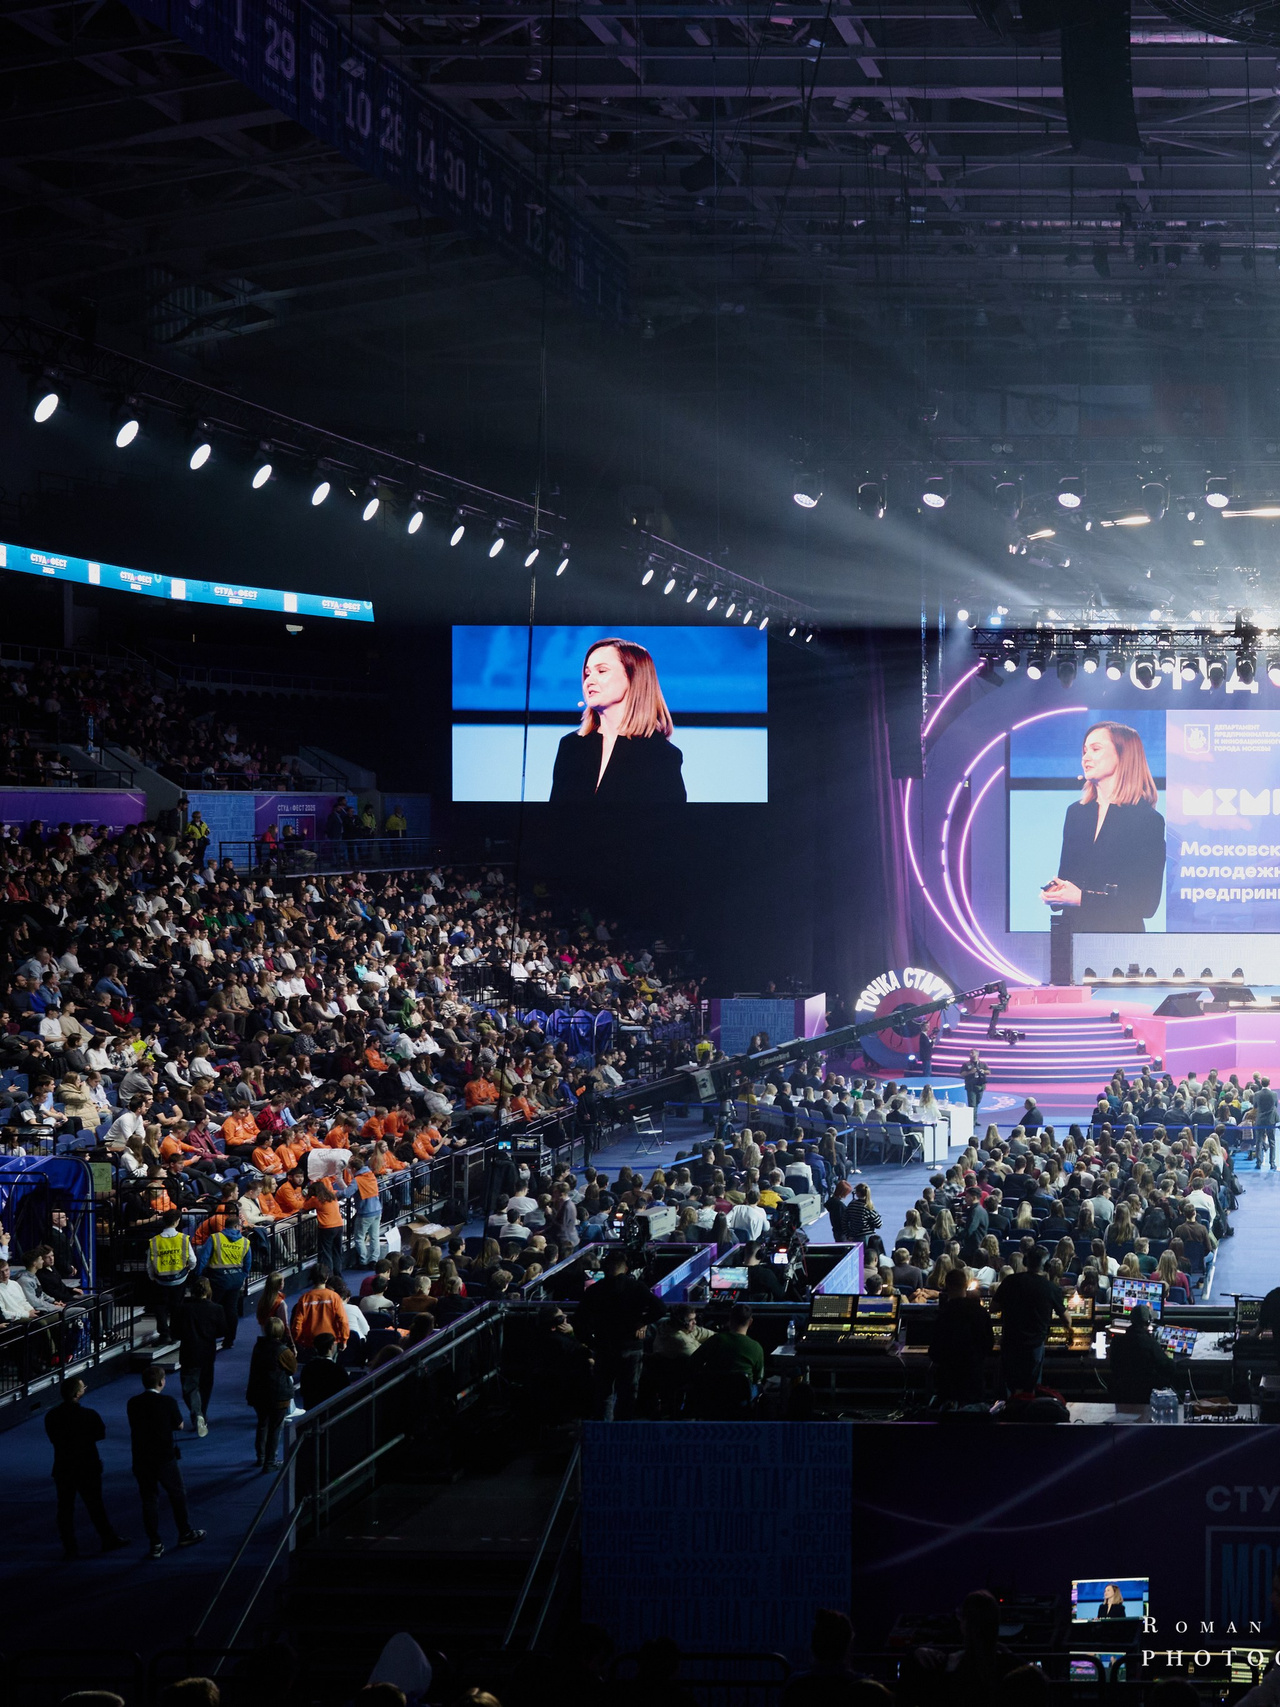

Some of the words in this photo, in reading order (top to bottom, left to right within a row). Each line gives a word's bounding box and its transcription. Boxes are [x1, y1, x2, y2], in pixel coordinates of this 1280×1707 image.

[265, 15, 296, 81] 29
[310, 50, 325, 103] 8
[345, 81, 371, 139] 10
[416, 129, 436, 181] 14
[444, 147, 466, 200] 30
[855, 970, 902, 1012] ТОЧКА
[903, 967, 955, 1001] СТАРТ
[641, 1466, 704, 1508] СТАРТА
[720, 1467, 744, 1508] НА
[750, 1467, 809, 1509] СТАРТ!
